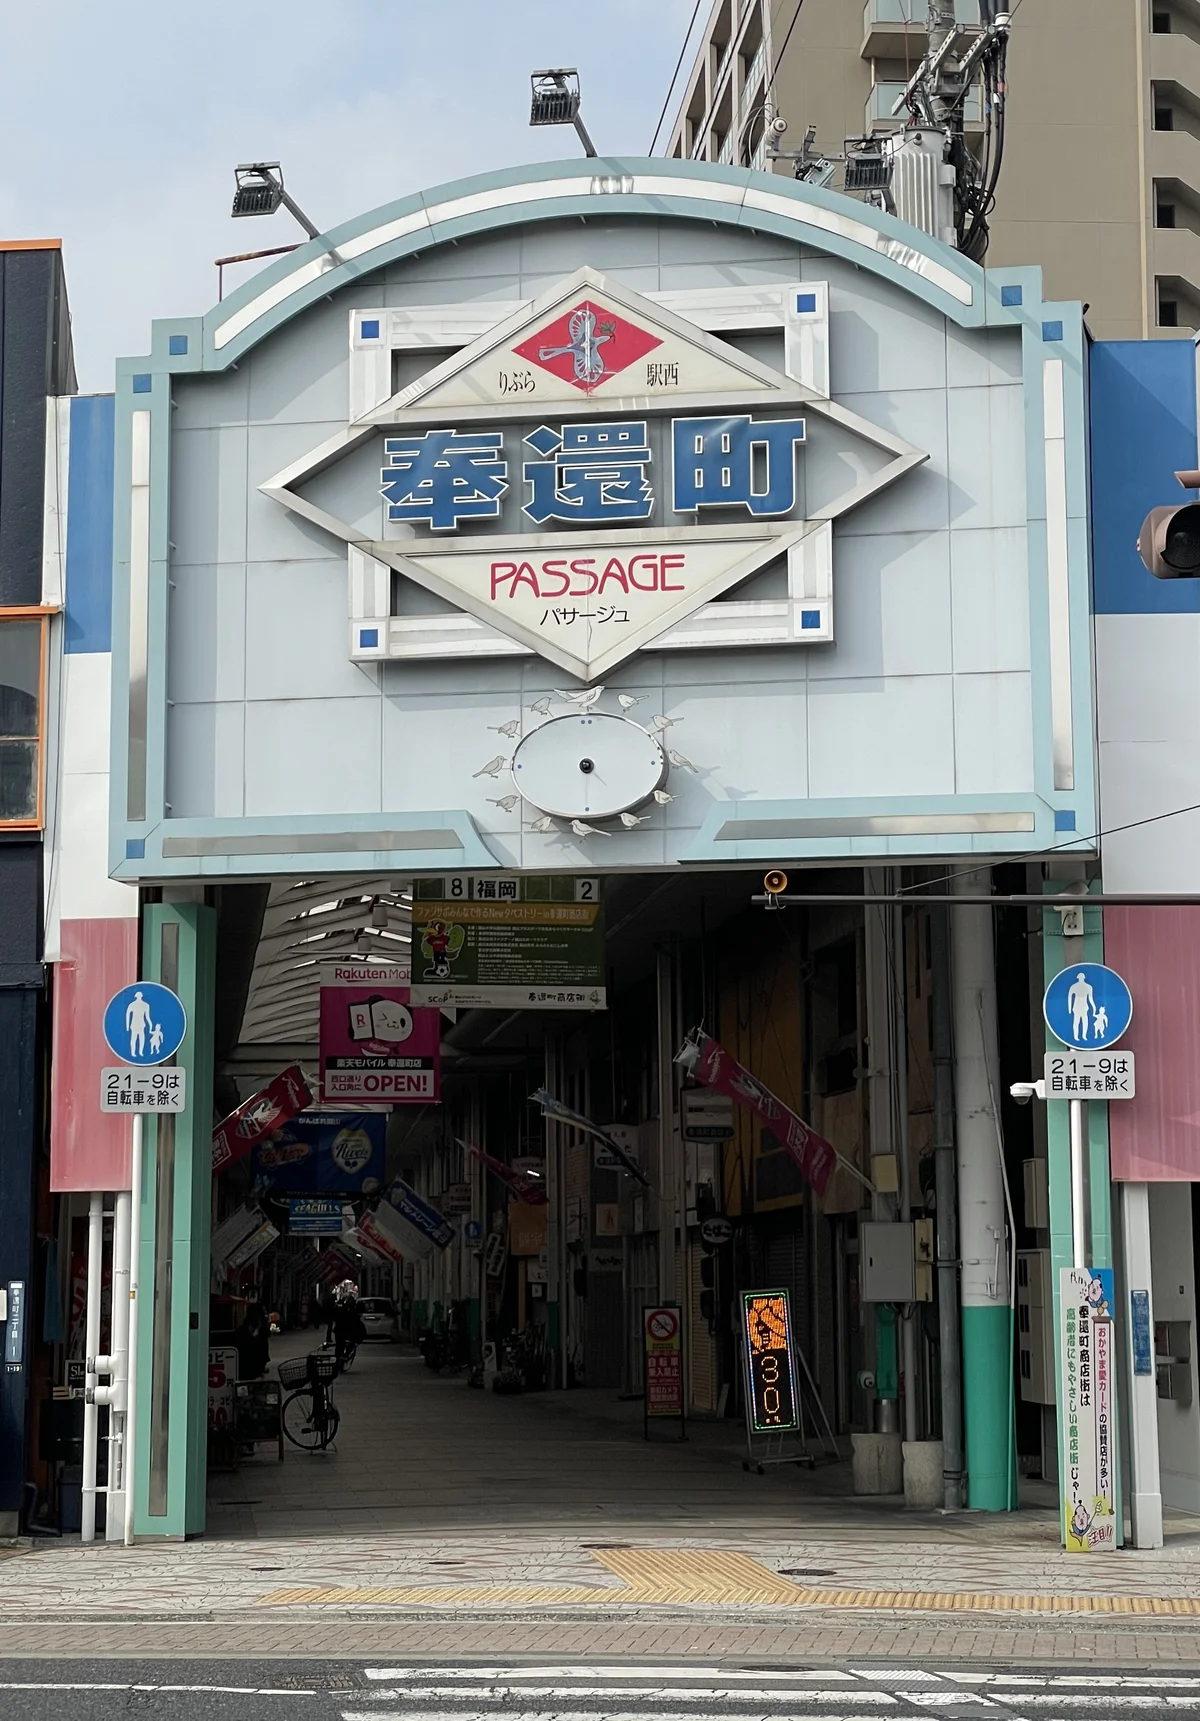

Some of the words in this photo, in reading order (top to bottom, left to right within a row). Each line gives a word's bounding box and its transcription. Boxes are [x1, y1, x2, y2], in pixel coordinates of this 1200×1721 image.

[499, 370, 536, 395] りぶら
[647, 362, 679, 387] 駅西
[380, 415, 806, 530] 奉還町
[491, 554, 685, 600] PASSAGE
[540, 605, 630, 626] パサージュ
[451, 878, 463, 897] 8
[477, 880, 517, 898] 福岡
[581, 881, 592, 900] 2
[334, 967, 387, 980] Rakuten
[336, 1058, 386, 1068] 楽天モバイル
[363, 1074, 427, 1092] OPEN!
[1052, 1075, 1128, 1092] 自転車を除く
[107, 1090, 179, 1106] 自転車を除く
[1078, 1305, 1091, 1407] 奉還町商店街は
